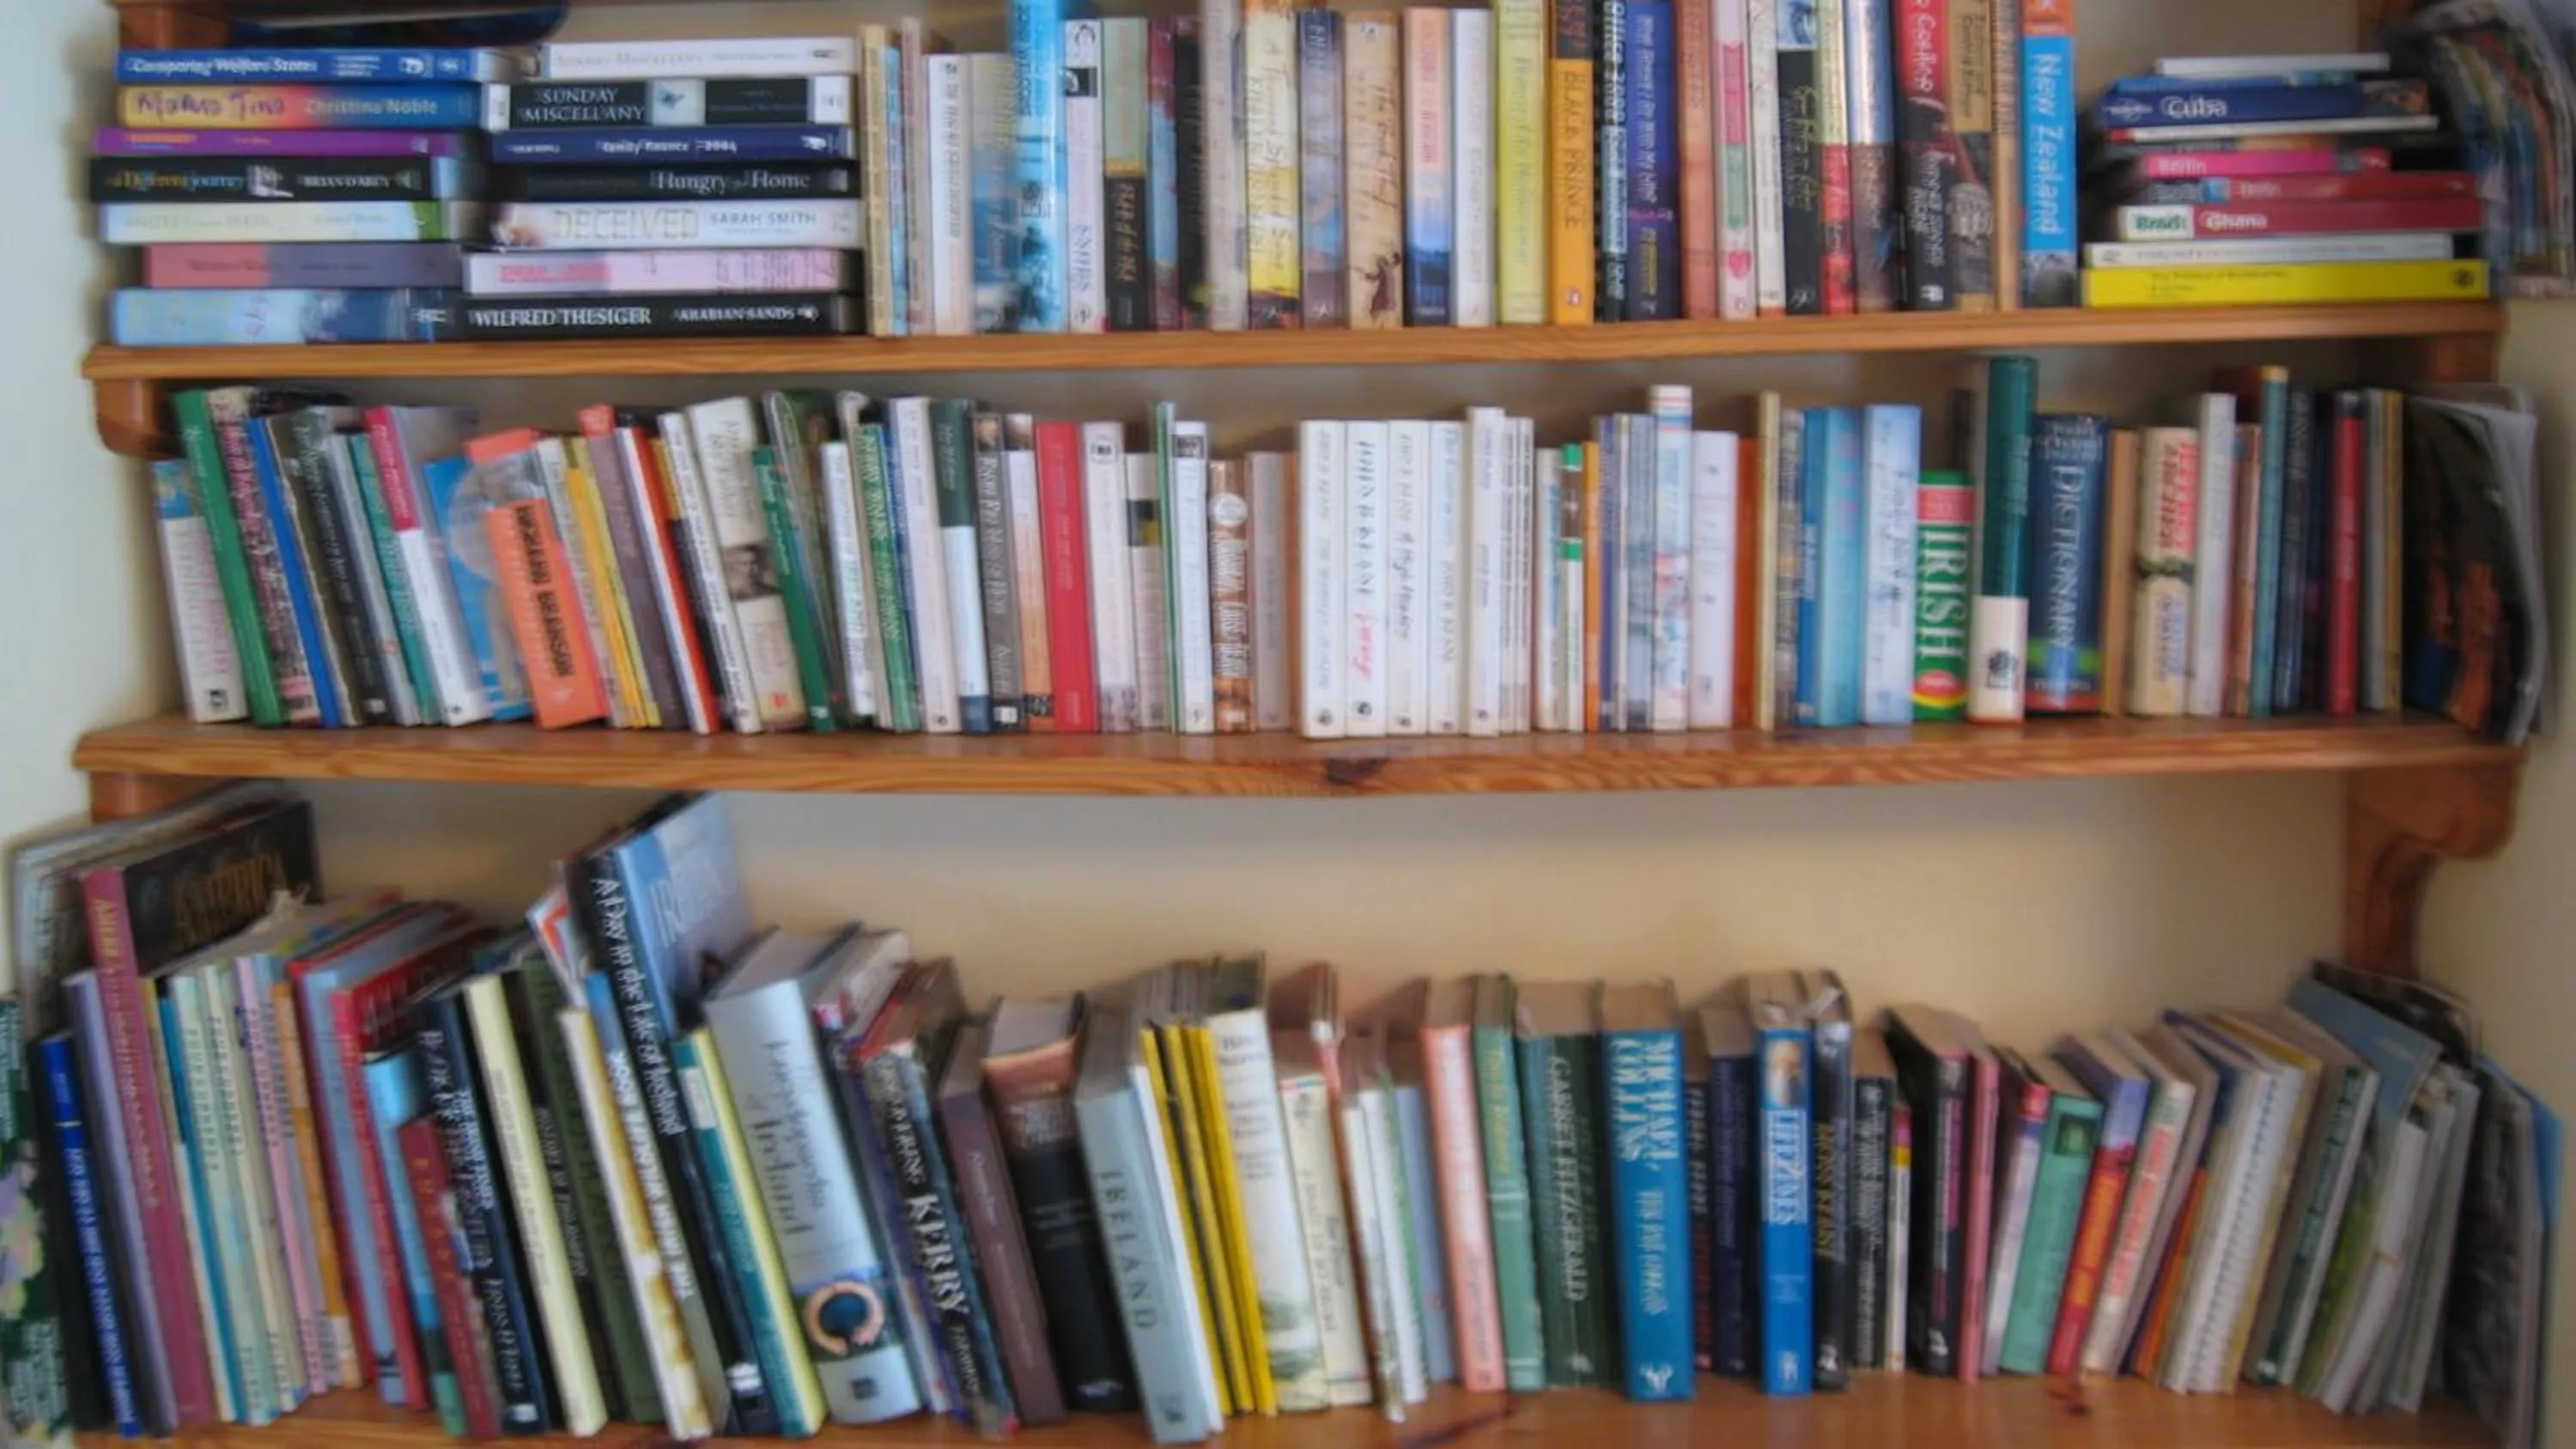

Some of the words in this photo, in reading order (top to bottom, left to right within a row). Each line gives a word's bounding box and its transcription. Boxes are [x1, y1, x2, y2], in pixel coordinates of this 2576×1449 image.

[125, 57, 212, 76] Comparing
[213, 56, 269, 74] Welfare
[271, 57, 318, 72] States
[536, 88, 618, 104] SUNDAY
[2031, 52, 2063, 115] New
[386, 96, 440, 115] Noble
[519, 105, 645, 122] MISCELLANY
[1562, 70, 1585, 140] BLACK
[2159, 94, 2227, 118] Cuba
[650, 169, 727, 194] Hungry
[747, 167, 811, 186] Home
[1563, 147, 1585, 229] PRINCE
[2027, 122, 2066, 234] Zealand
[550, 207, 699, 241] DECEIVED
[709, 211, 762, 225] SARAH
[767, 210, 817, 225] SMITH
[2196, 209, 2267, 230] Ghana
[469, 306, 556, 327] WILFRED
[560, 305, 652, 325] THESIGER
[2044, 464, 2086, 650] DICTIONARY
[513, 501, 552, 587] RICHARD
[535, 586, 575, 680] BRANSON
[1914, 528, 1969, 661] IRISH
[593, 892, 635, 945] Day
[615, 962, 652, 1005] the
[625, 998, 665, 1048] Life
[605, 1048, 641, 1107] BOOK
[642, 1062, 690, 1139] Ireland
[1543, 1053, 1579, 1151] GARRET
[1607, 1035, 1653, 1163] COLLINS
[1640, 1038, 1684, 1161] MICHAEL
[620, 1107, 666, 1202] WILDLIFE
[752, 1119, 815, 1235] Ireland
[647, 1201, 683, 1259] IRISH
[1552, 1155, 1592, 1304] FITZGERALD
[1634, 1187, 1666, 1222] TIM
[905, 1193, 969, 1317] KERRY
[1097, 1166, 1159, 1335] IRELAND
[1636, 1221, 1668, 1252] PAT
